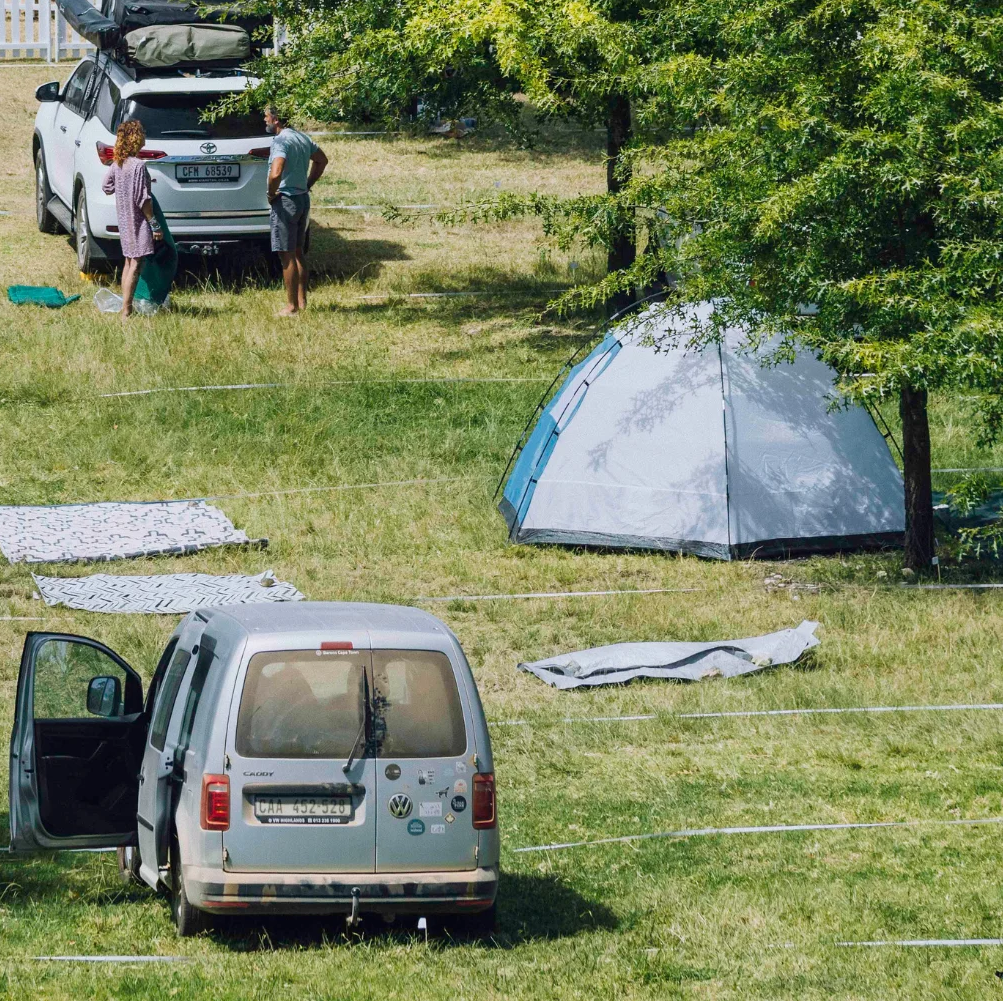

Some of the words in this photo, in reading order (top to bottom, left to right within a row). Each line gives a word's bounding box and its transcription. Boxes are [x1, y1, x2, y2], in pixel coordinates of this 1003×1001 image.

[205, 165, 232, 176] 68539
[259, 799, 283, 814] CAA
[292, 799, 346, 814] 452-528
